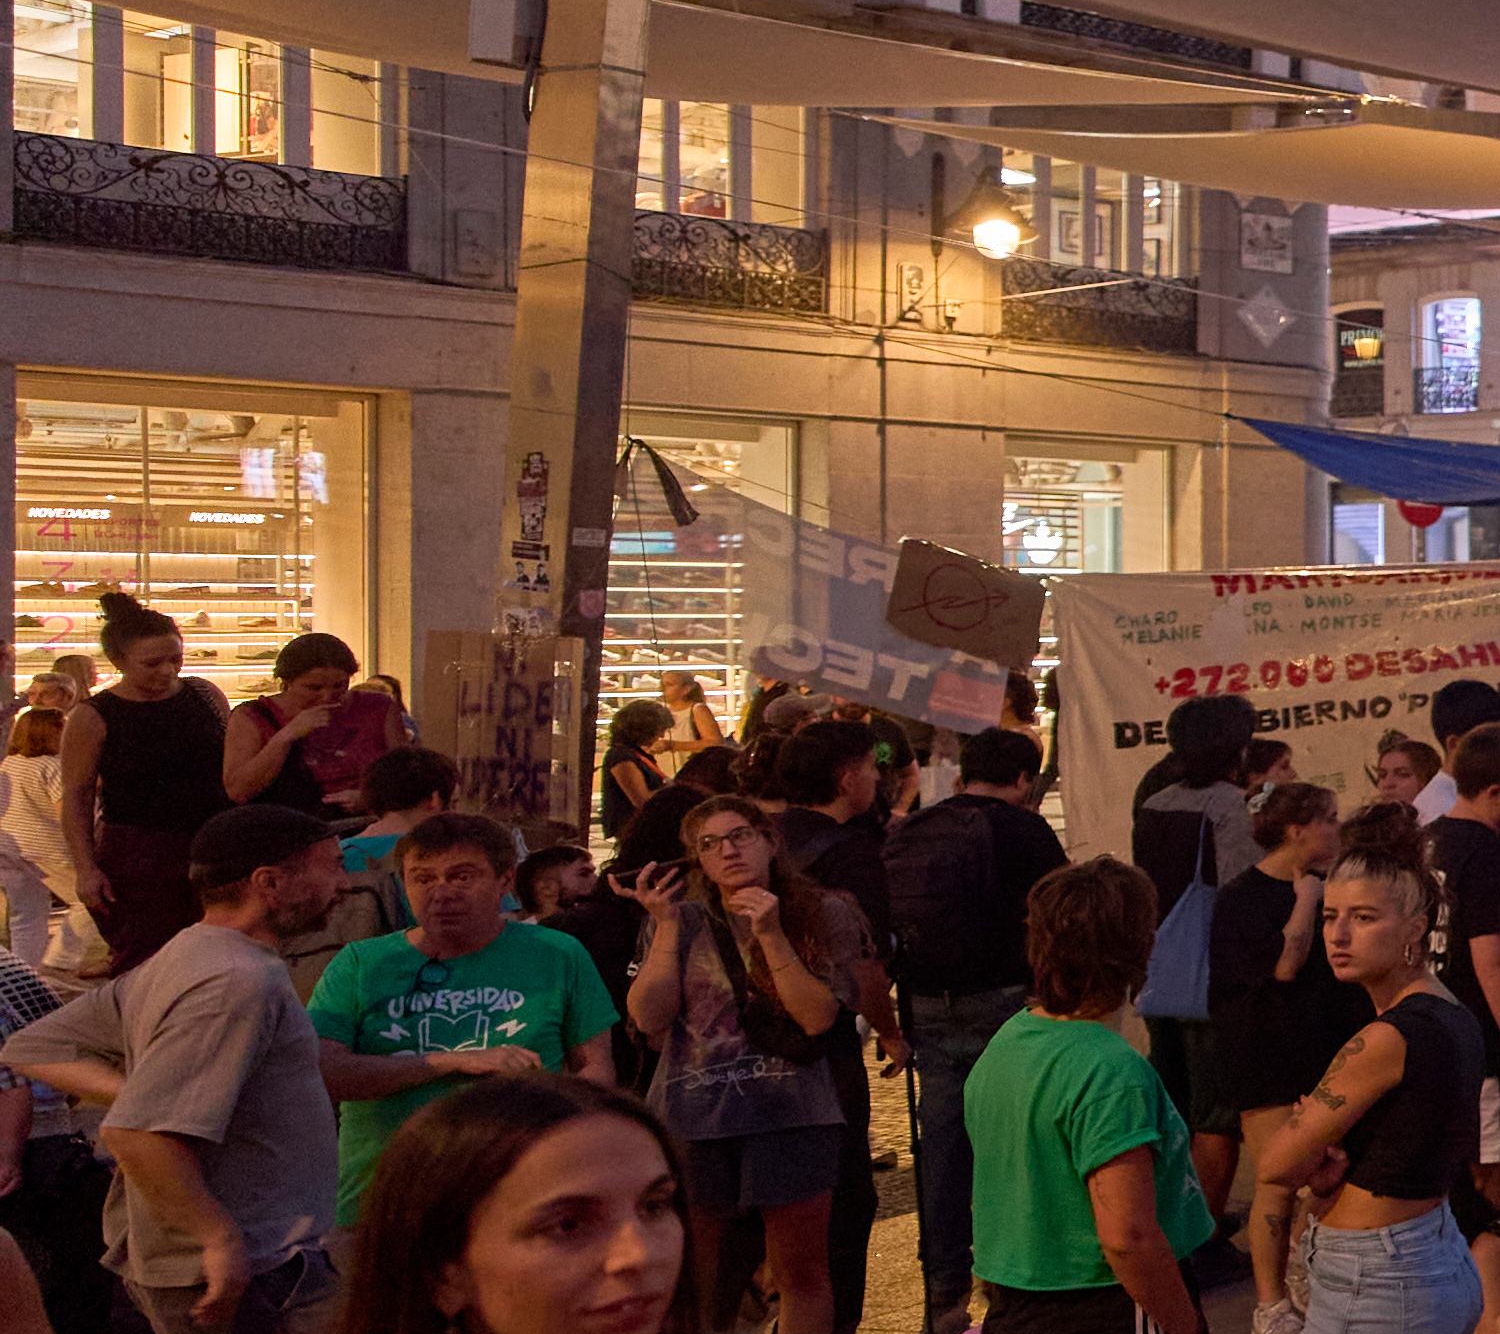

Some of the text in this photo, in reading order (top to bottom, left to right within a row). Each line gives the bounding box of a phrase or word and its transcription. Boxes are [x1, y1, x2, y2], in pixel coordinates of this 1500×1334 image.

[27, 506, 111, 520] NOVEDADES
[188, 510, 266, 525] NOVEDADES
[1303, 591, 1354, 609] DAVID
[41, 615, 76, 651] 2
[1114, 610, 1179, 630] CHARO
[1121, 624, 1203, 645] MELANIE
[1300, 613, 1382, 635] MONTSE
[494, 725, 534, 765] NI
[386, 986, 525, 1020] UNIVERSIDAD
